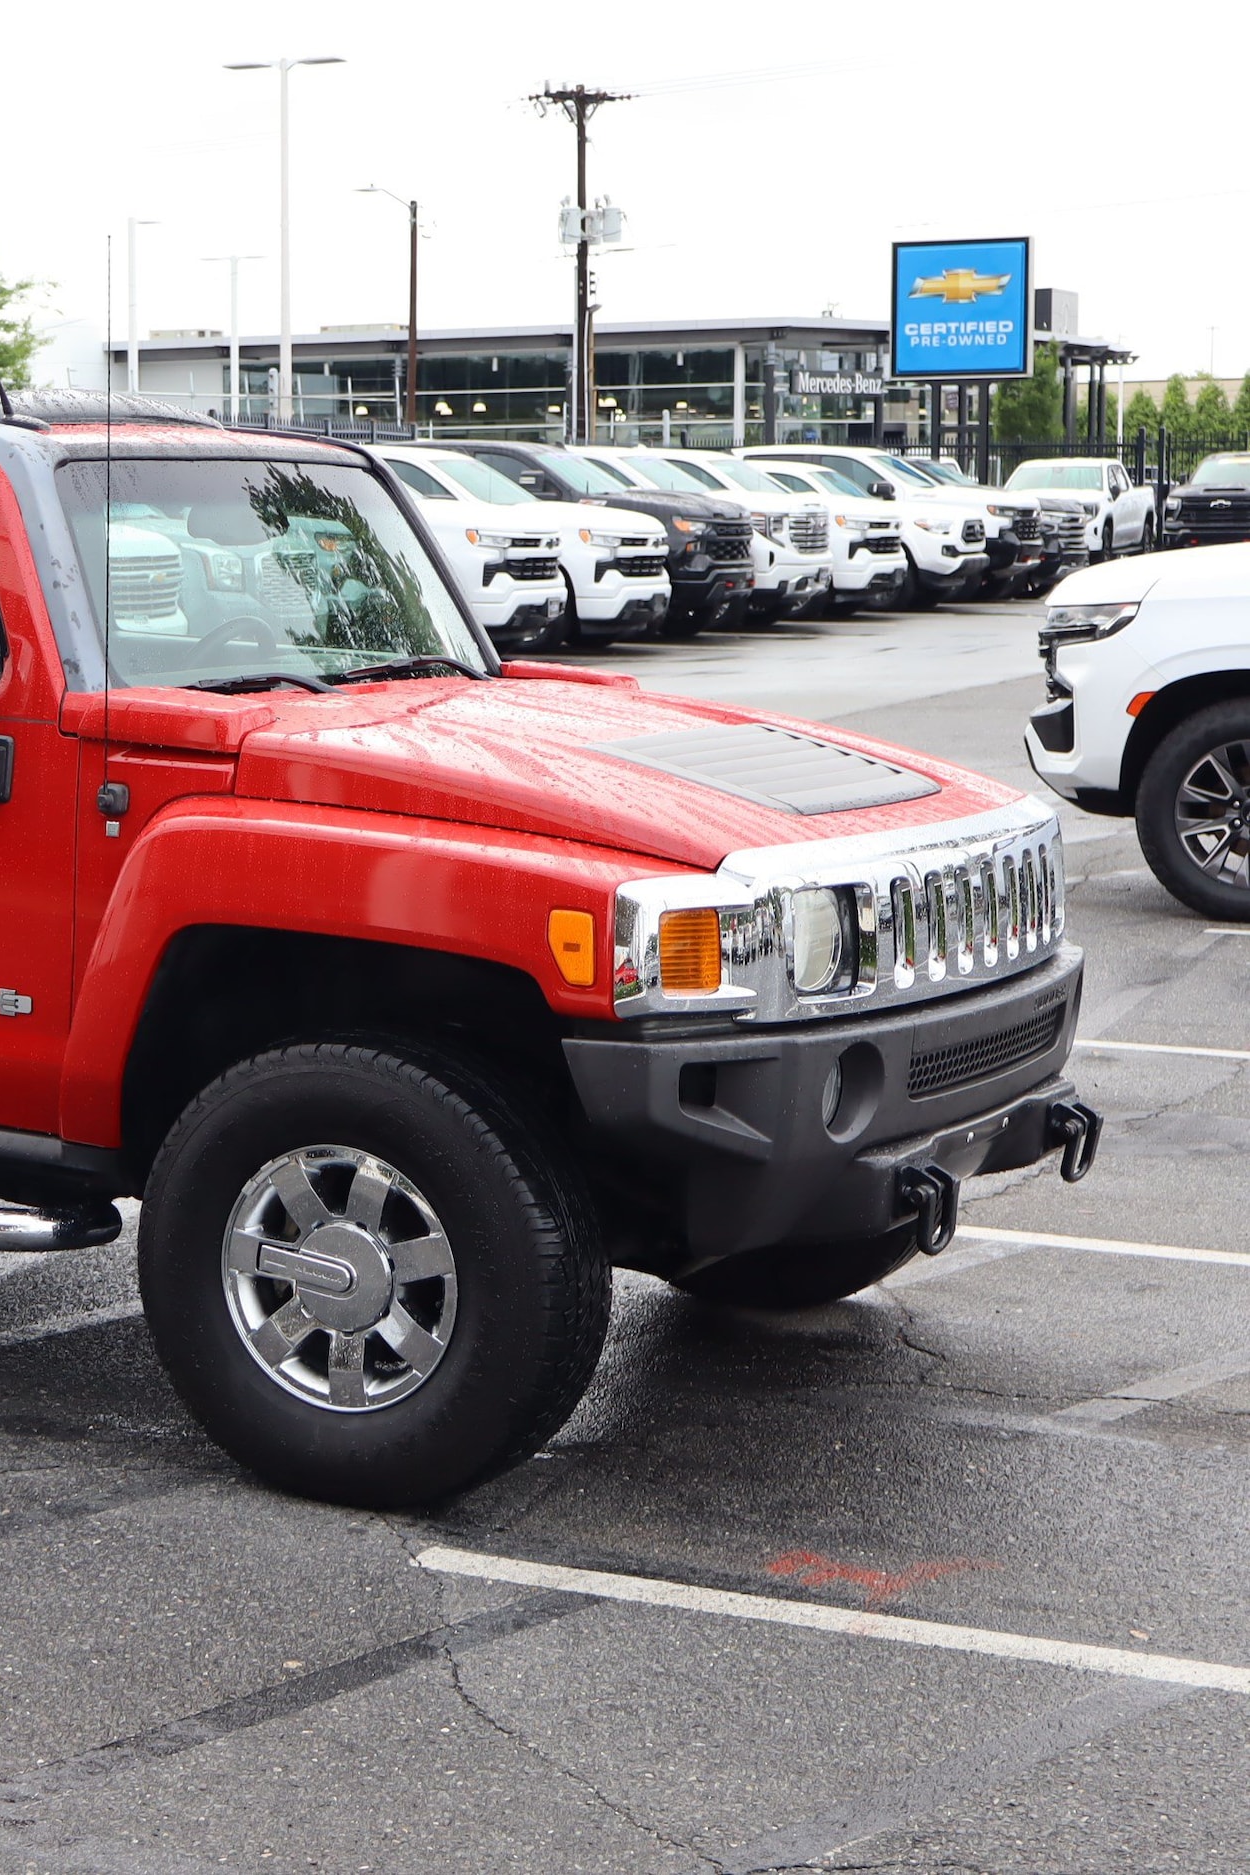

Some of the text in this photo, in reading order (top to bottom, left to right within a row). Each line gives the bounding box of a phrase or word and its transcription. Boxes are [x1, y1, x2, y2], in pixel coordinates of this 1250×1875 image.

[904, 320, 1014, 336] CERTIFIED
[910, 333, 1007, 348] PRE-OWNED
[797, 371, 882, 394] Mercedes-Benz
